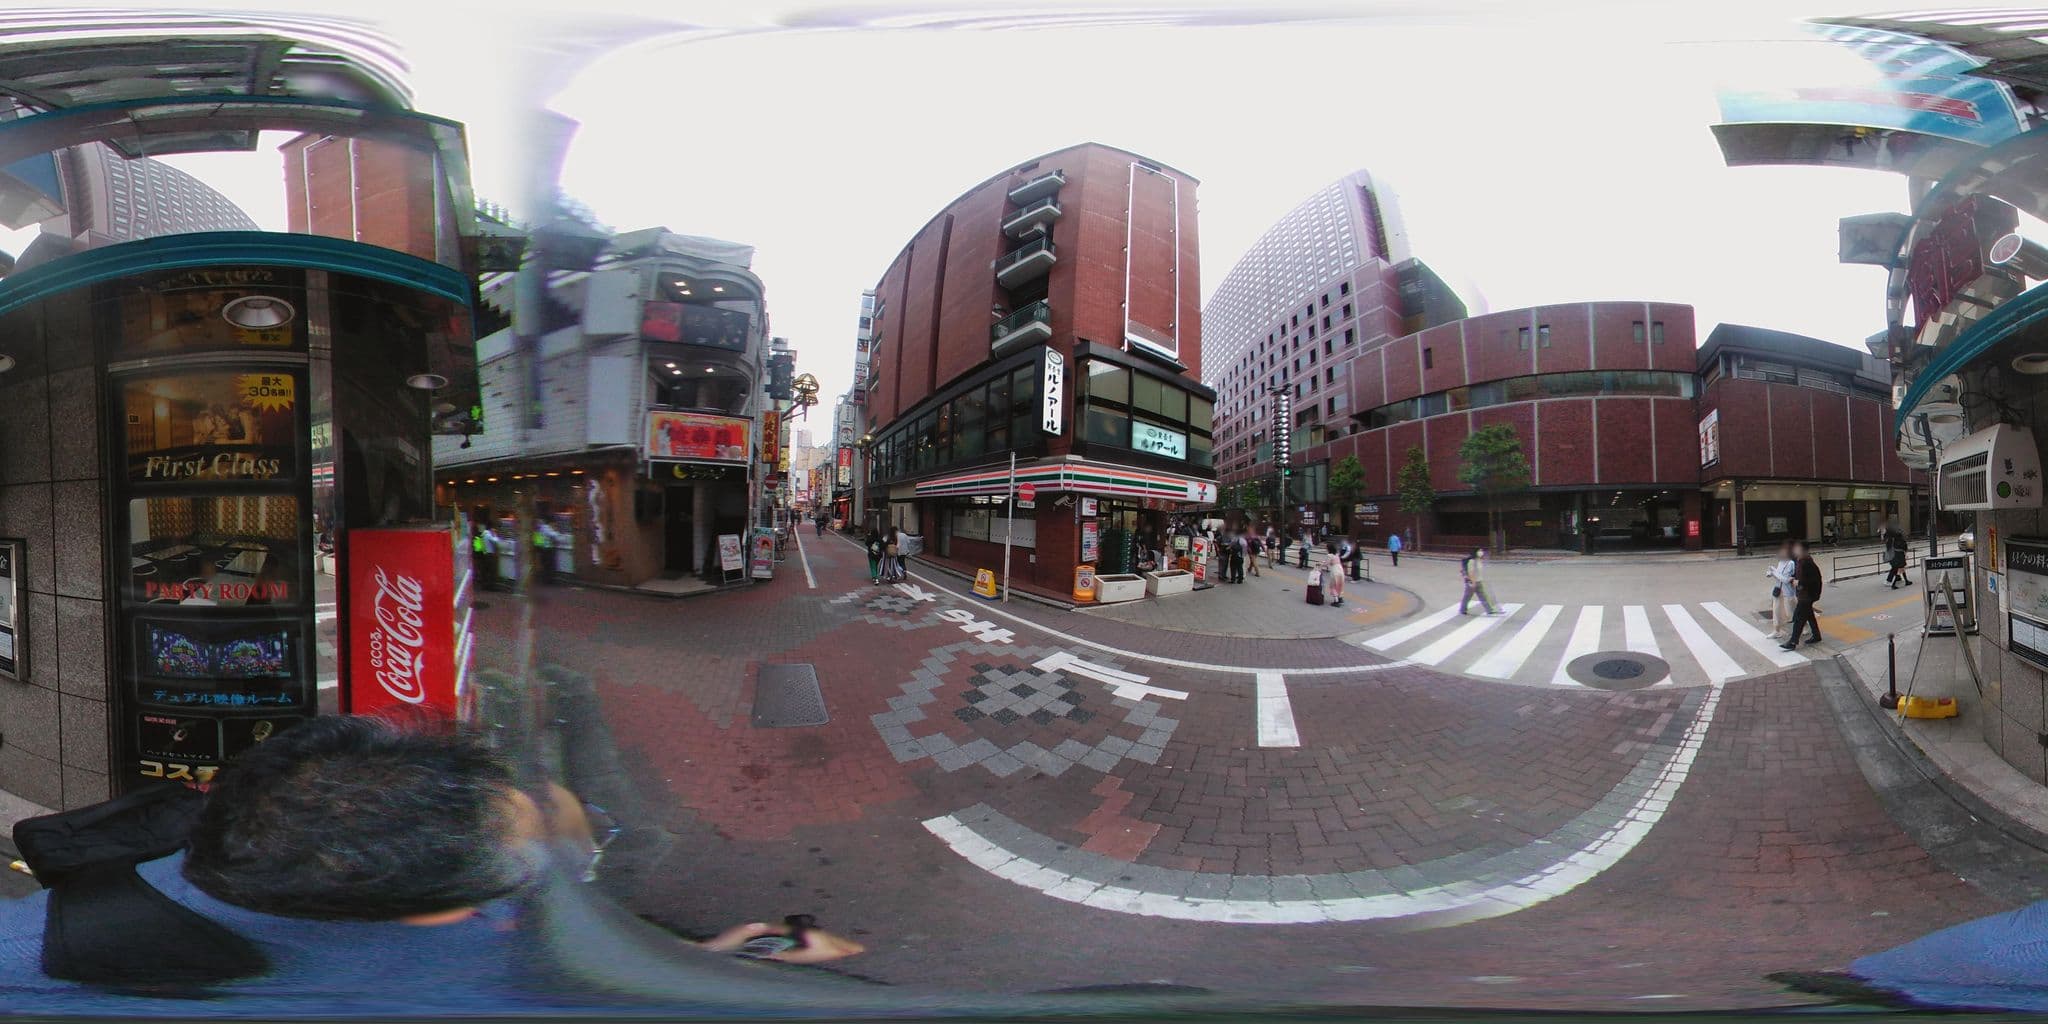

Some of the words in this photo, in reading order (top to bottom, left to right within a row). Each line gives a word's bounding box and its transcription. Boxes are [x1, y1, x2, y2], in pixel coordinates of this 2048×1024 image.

[261, 376, 282, 386] 最大
[1046, 374, 1059, 431] ルノアール
[144, 455, 207, 478] First
[213, 452, 281, 476] Class
[2012, 551, 2048, 569] 只今の料
[145, 581, 213, 600] PARTY
[219, 580, 288, 600] ROOM
[374, 565, 425, 704] Coca-Cola
